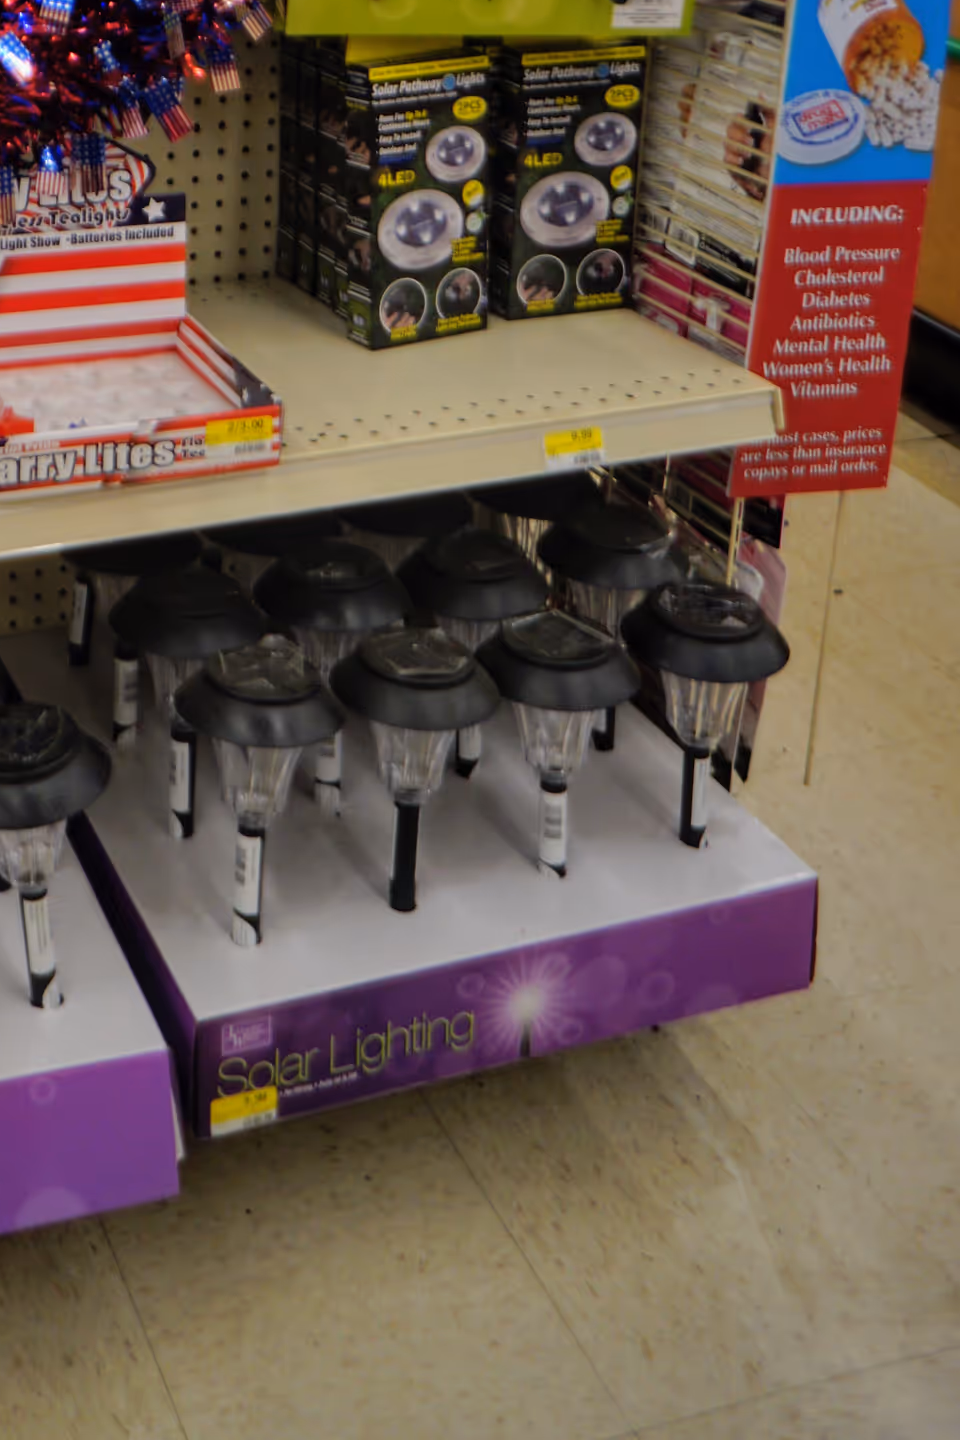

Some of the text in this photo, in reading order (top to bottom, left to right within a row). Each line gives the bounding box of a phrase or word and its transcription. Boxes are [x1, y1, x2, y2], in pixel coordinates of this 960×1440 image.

[524, 61, 640, 80] Solar Pathway Lights
[371, 72, 486, 96] Solar Pathway Lights
[49, 210, 131, 226] Tealights
[790, 205, 904, 225] INCLUDING:
[0, 233, 28, 250] Light
[30, 231, 61, 248] Show
[70, 224, 174, 245] Batteries Included
[784, 245, 900, 264] Blood Pressure
[794, 266, 885, 287] Cholesterol
[802, 290, 871, 309] Diabetes
[790, 313, 875, 332] Antibiotics
[773, 333, 886, 354] Mental Health
[762, 354, 891, 378] Women's Health
[790, 378, 858, 398] Vitamins
[802, 430, 840, 443] cases,
[843, 425, 882, 443] prices
[83, 439, 177, 472] Lites
[740, 443, 886, 463] are less than insurance
[743, 465, 788, 482] copays
[792, 465, 806, 476] or
[809, 459, 838, 475] mail
[218, 1047, 320, 1098] Solar
[330, 1011, 475, 1075] Lighting
